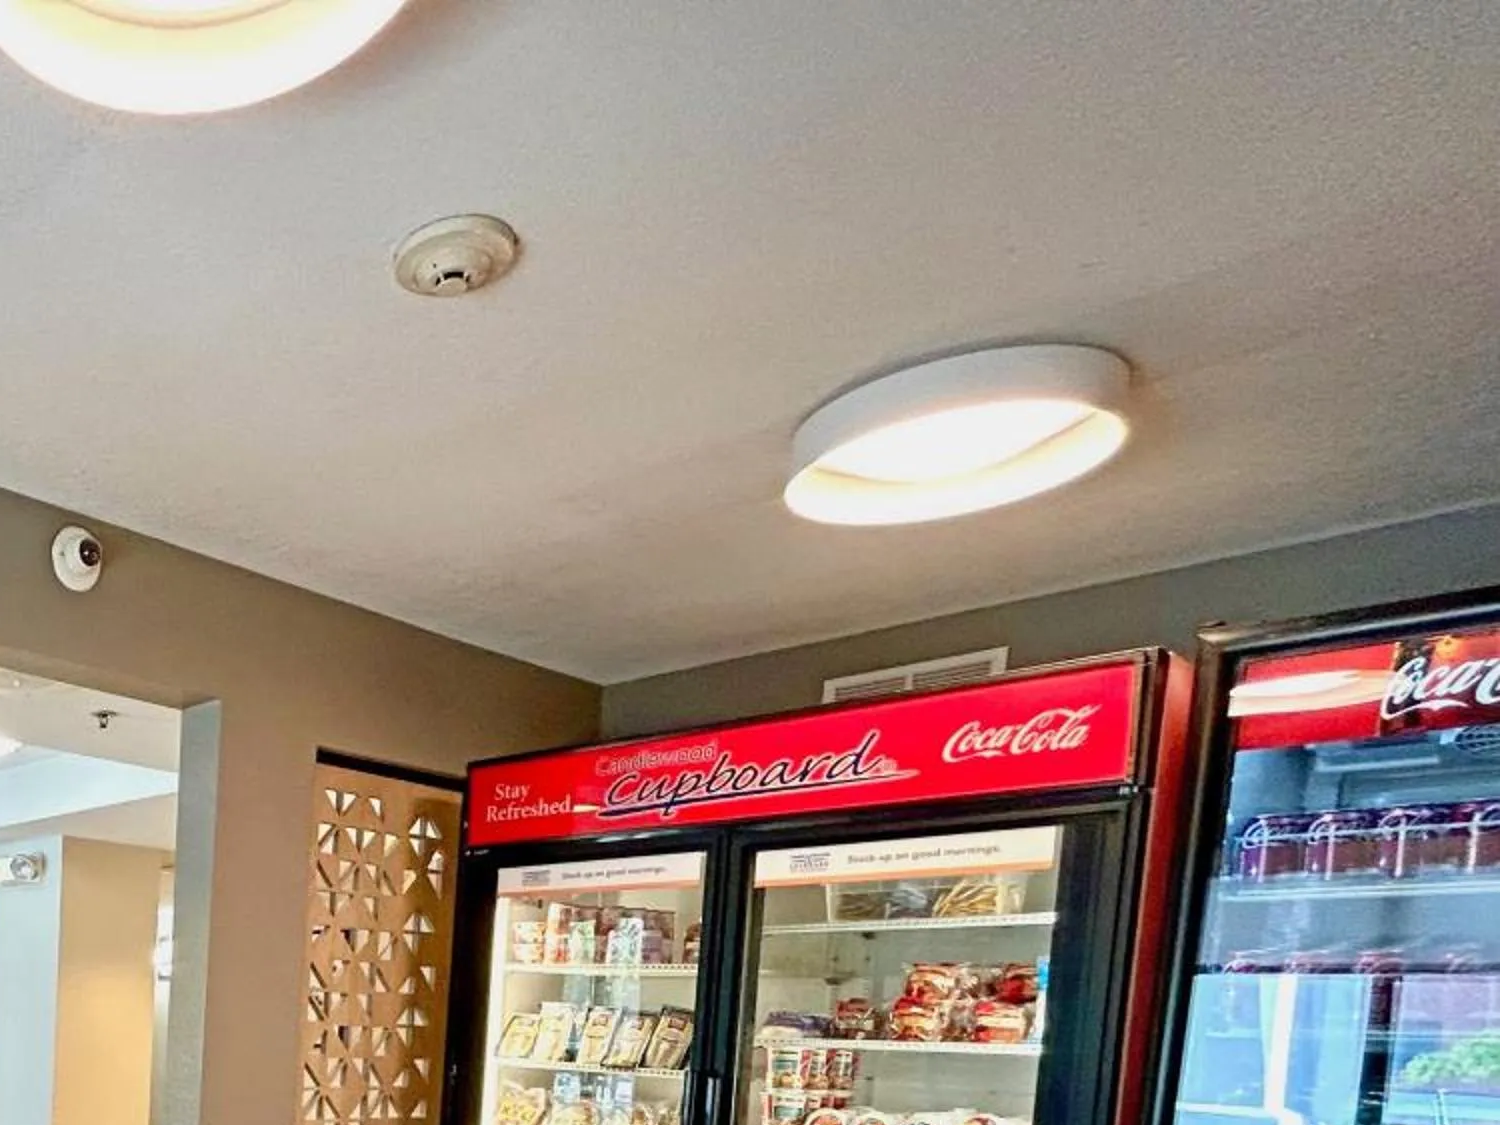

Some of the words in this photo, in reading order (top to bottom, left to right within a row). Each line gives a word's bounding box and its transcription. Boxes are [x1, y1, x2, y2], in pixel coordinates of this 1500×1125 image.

[596, 739, 719, 776] Candlewood
[941, 704, 1102, 763] Coca-Cola
[494, 783, 530, 802] Stay
[605, 730, 882, 817] Cupboard
